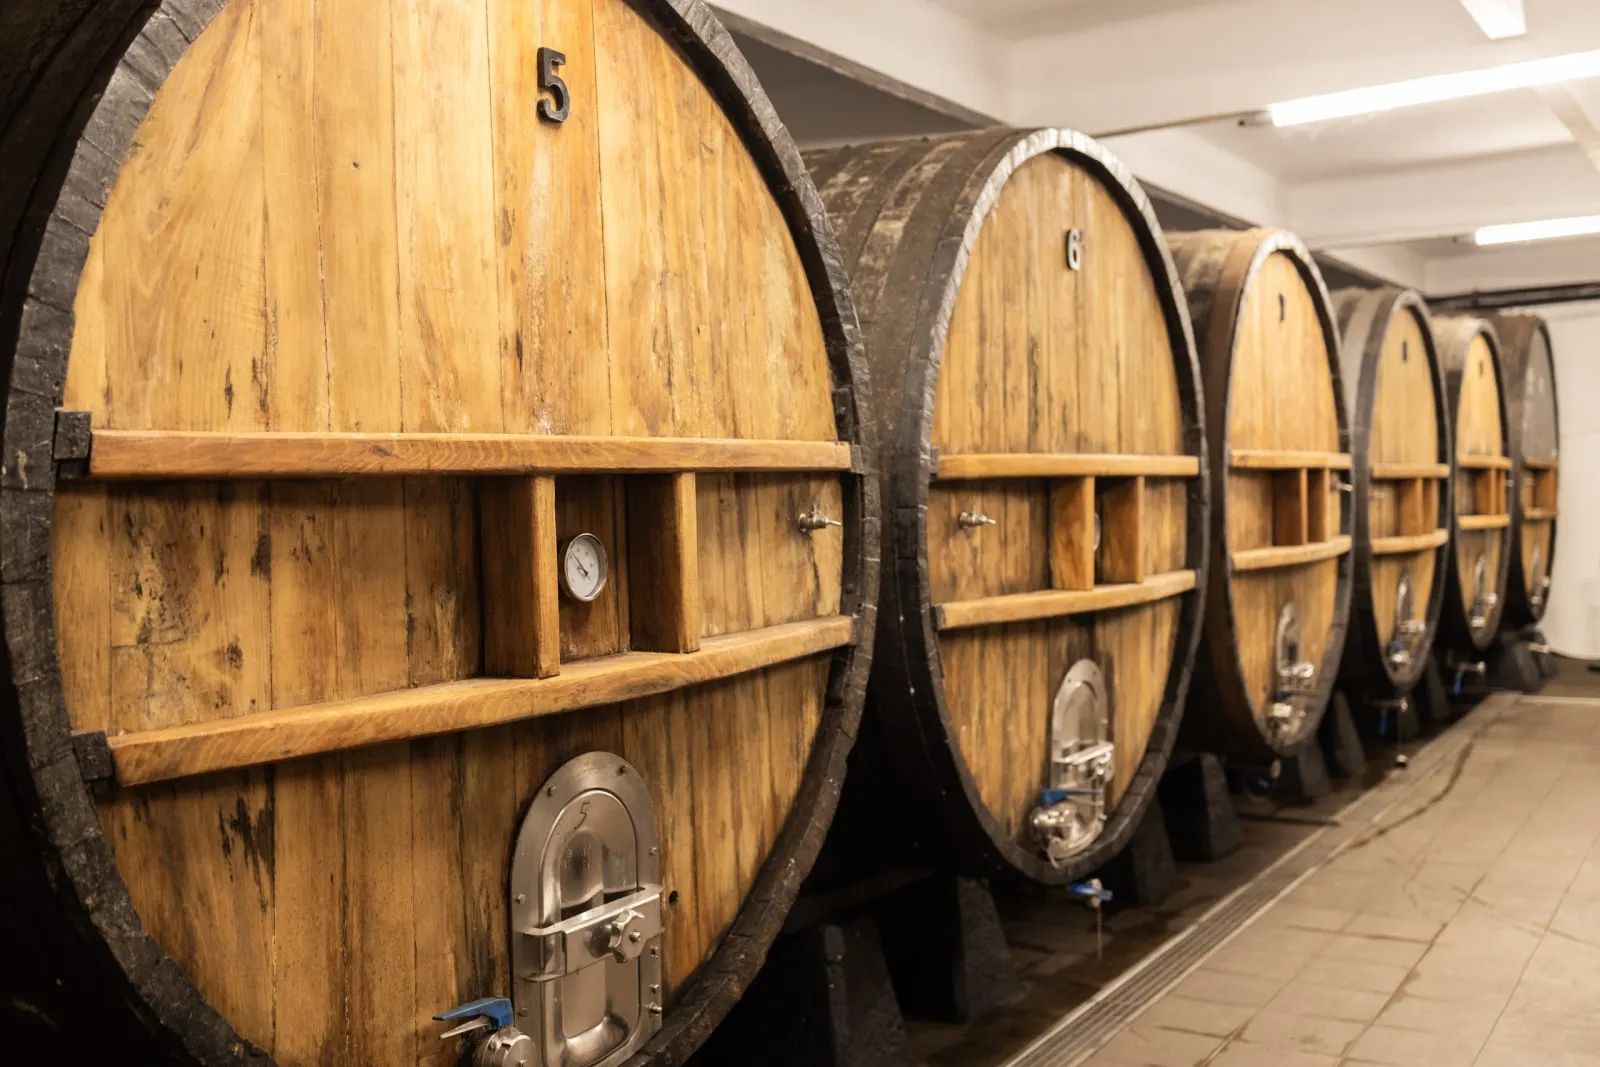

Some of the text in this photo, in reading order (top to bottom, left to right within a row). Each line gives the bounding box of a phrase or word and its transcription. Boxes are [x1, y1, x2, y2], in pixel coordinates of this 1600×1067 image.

[537, 47, 570, 123] 5
[1065, 228, 1081, 271] 6
[573, 801, 591, 830] 5
